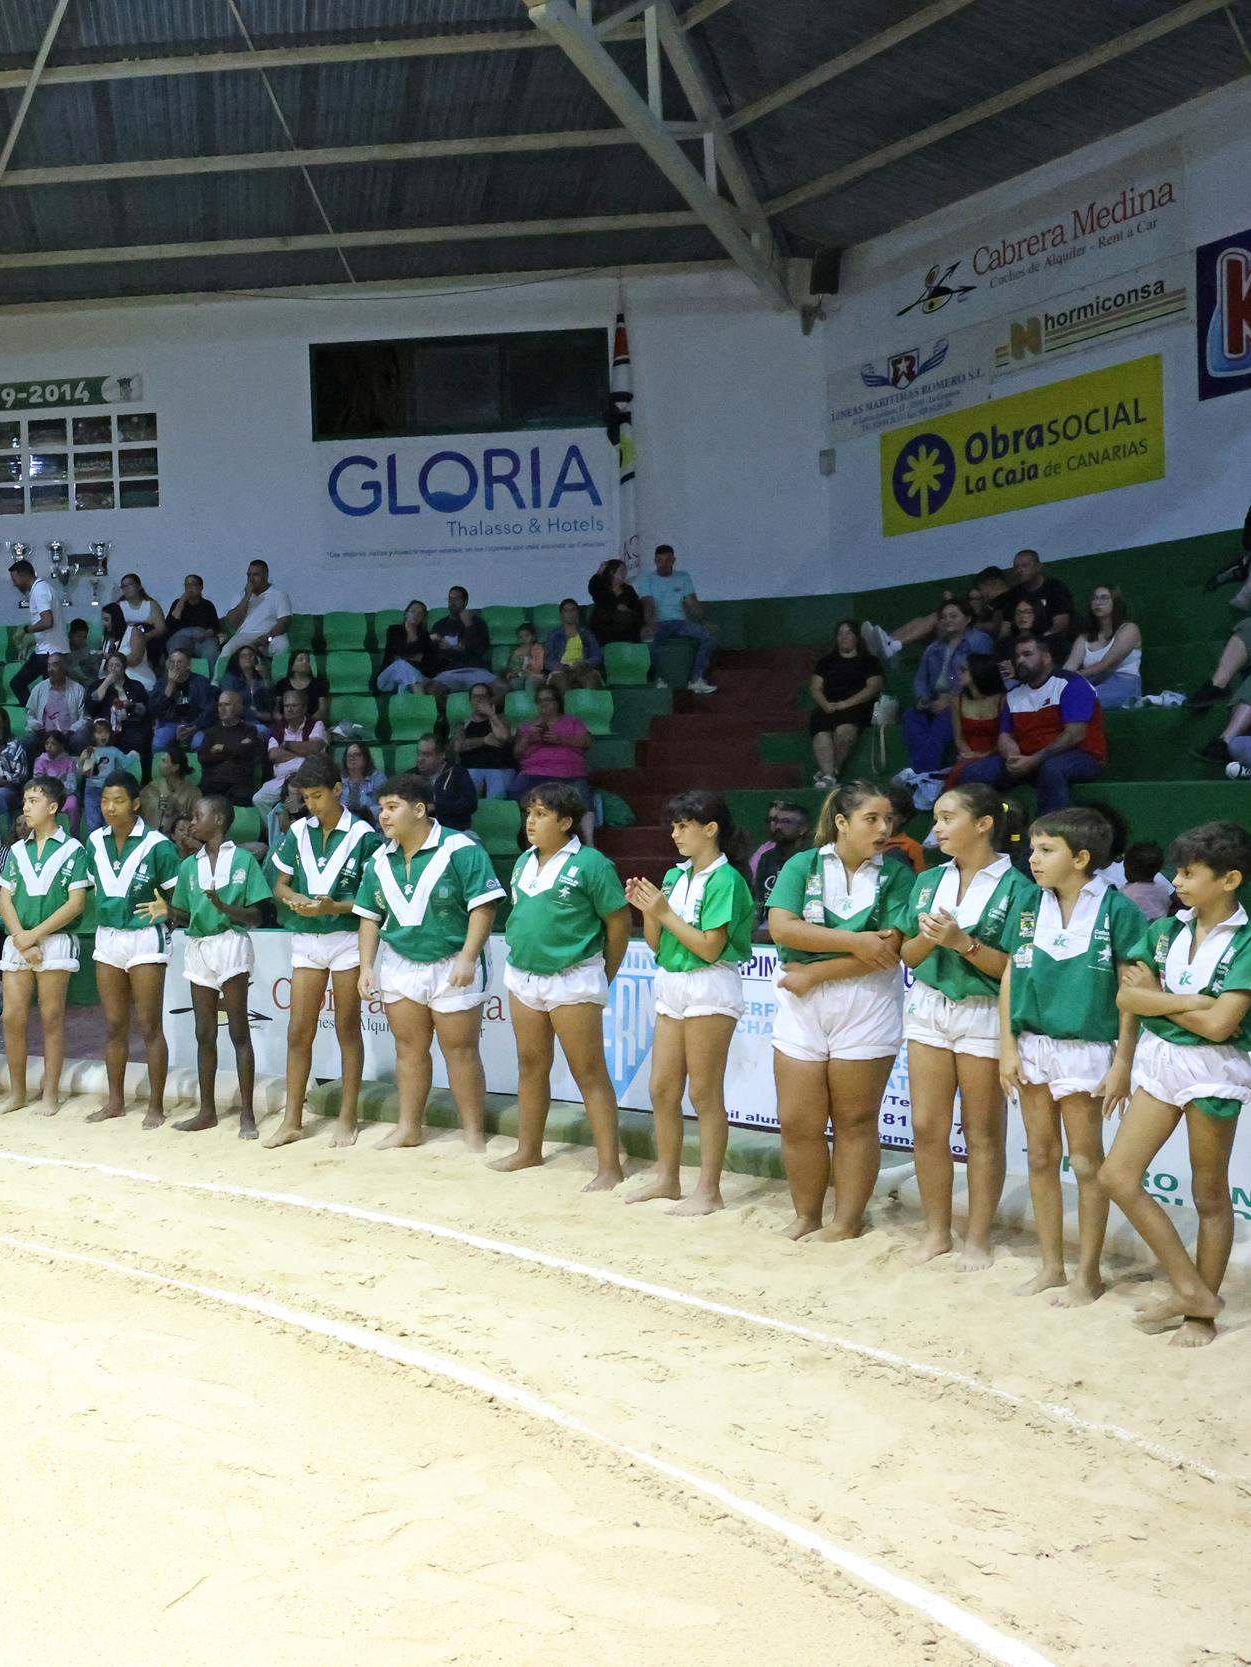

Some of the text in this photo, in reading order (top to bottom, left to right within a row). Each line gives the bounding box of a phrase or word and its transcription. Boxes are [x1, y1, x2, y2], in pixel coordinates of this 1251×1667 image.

[973, 182, 1176, 276] Cabrera Medina
[1044, 245, 1086, 269] Alquiler
[1098, 231, 1124, 248] Rent
[1136, 218, 1158, 234] Car
[1044, 279, 1165, 331] hormiconsa
[921, 373, 966, 395] ROMERO
[328, 445, 603, 517] GLORIA
[964, 439, 1149, 495] La Caja de CANARIAS
[446, 516, 604, 537] Thalasso & Hotels
